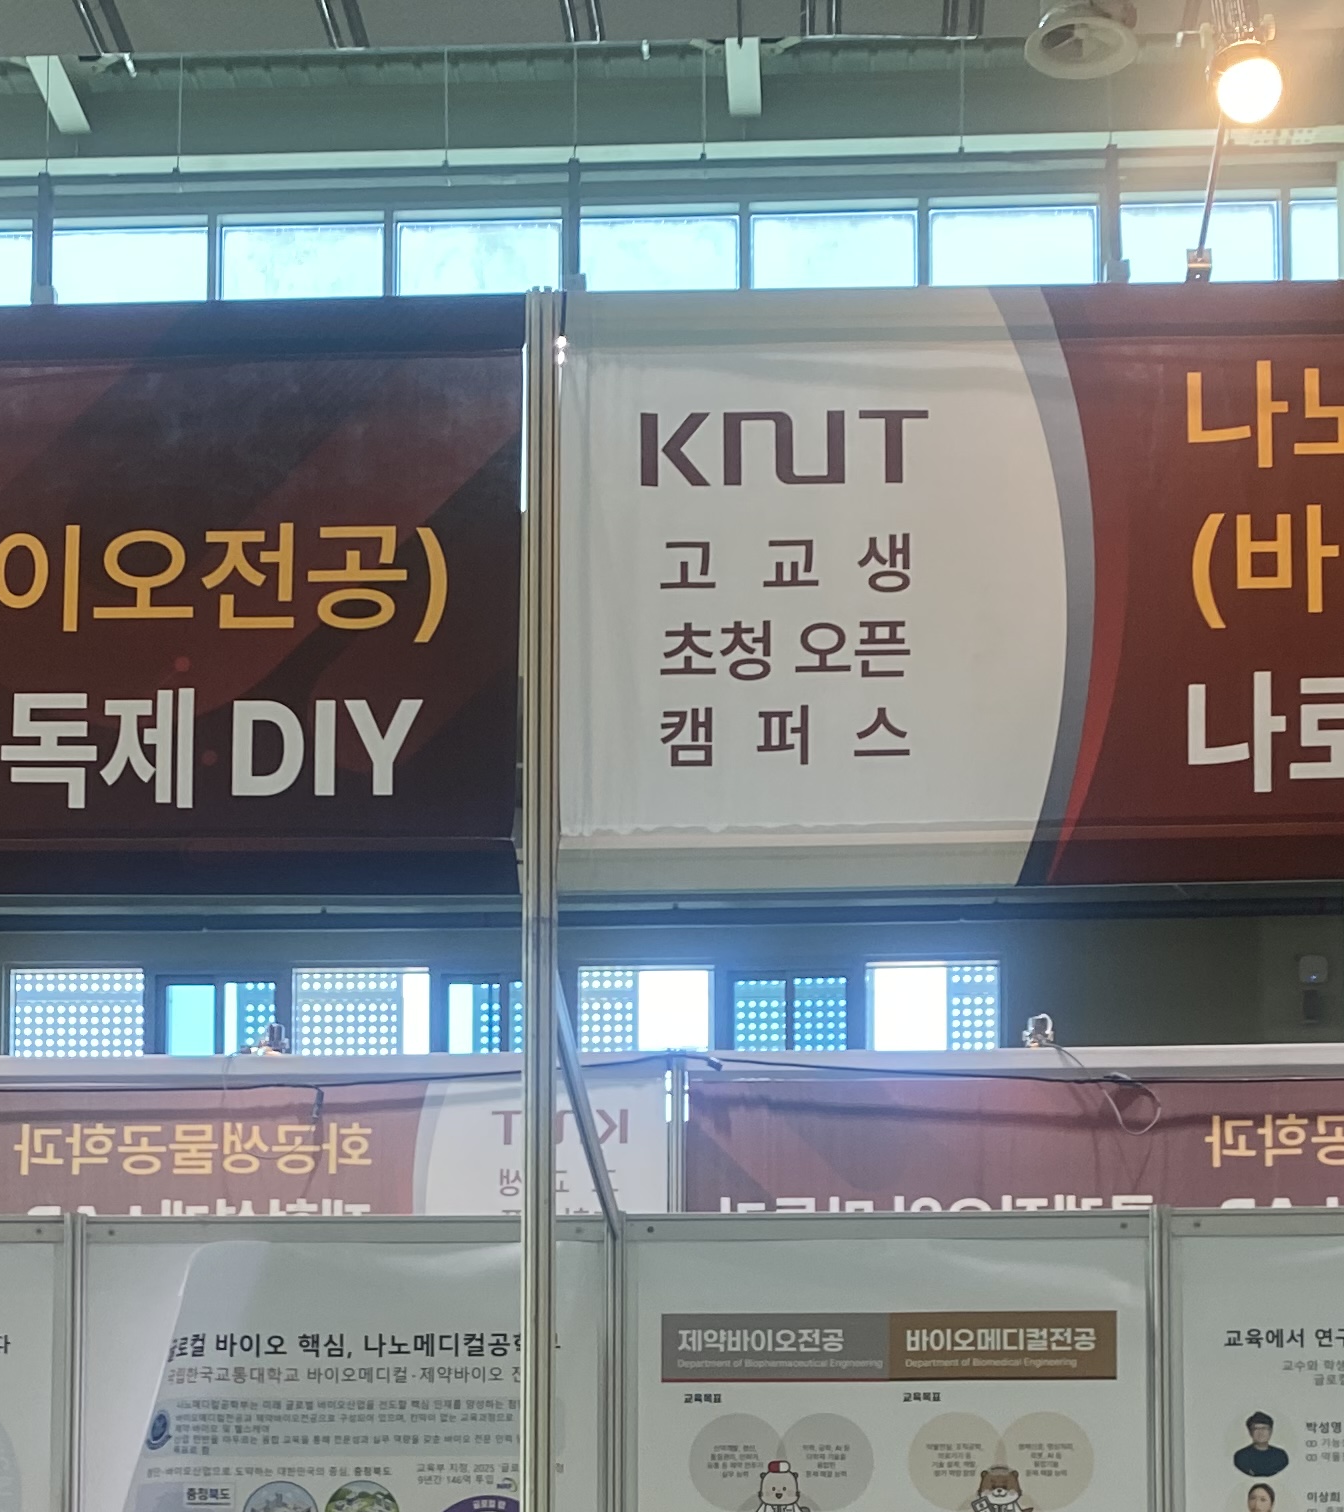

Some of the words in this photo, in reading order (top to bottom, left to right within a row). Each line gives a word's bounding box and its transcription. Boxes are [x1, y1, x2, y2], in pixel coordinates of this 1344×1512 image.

[640, 410, 929, 488] KNUT
[660, 620, 772, 682] 초청
[795, 620, 911, 679] 오픈
[232, 699, 423, 798] DIY
[215, 1332, 288, 1359] 바이오
[297, 1333, 352, 1359] 핵심,
[677, 1328, 845, 1353] 제약바이오전공
[906, 1327, 1097, 1352] 바이오메디컬전공
[1223, 1327, 1305, 1349] 교육에서
